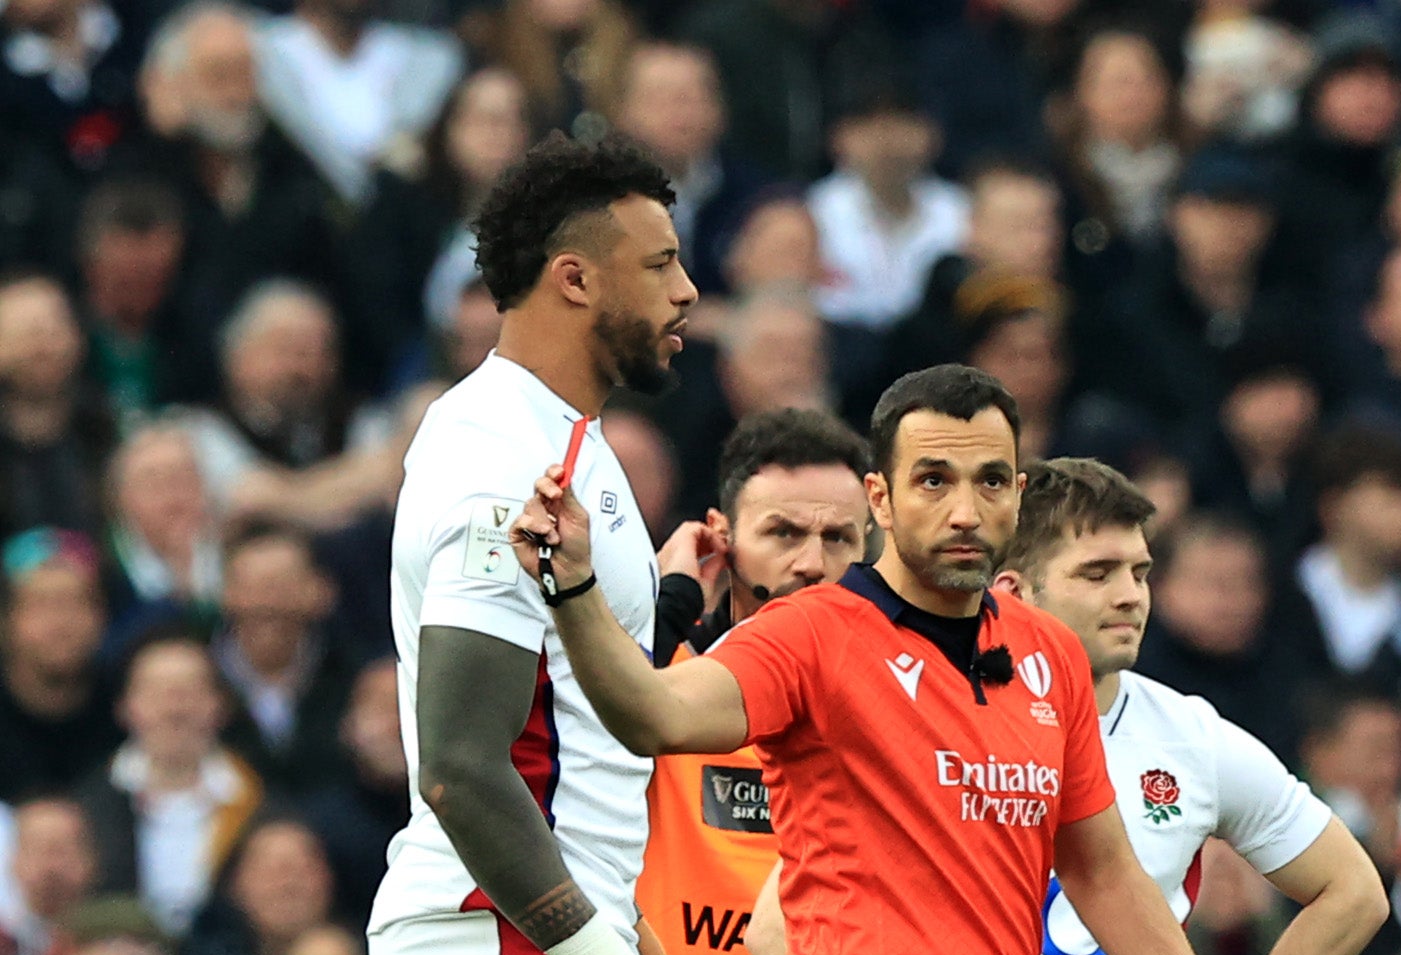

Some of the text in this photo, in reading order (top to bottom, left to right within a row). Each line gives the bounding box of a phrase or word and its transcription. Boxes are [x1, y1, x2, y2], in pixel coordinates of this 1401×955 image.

[934, 750, 1060, 797] Emirates
[732, 806, 757, 819] SIX
[682, 901, 753, 952] WA
